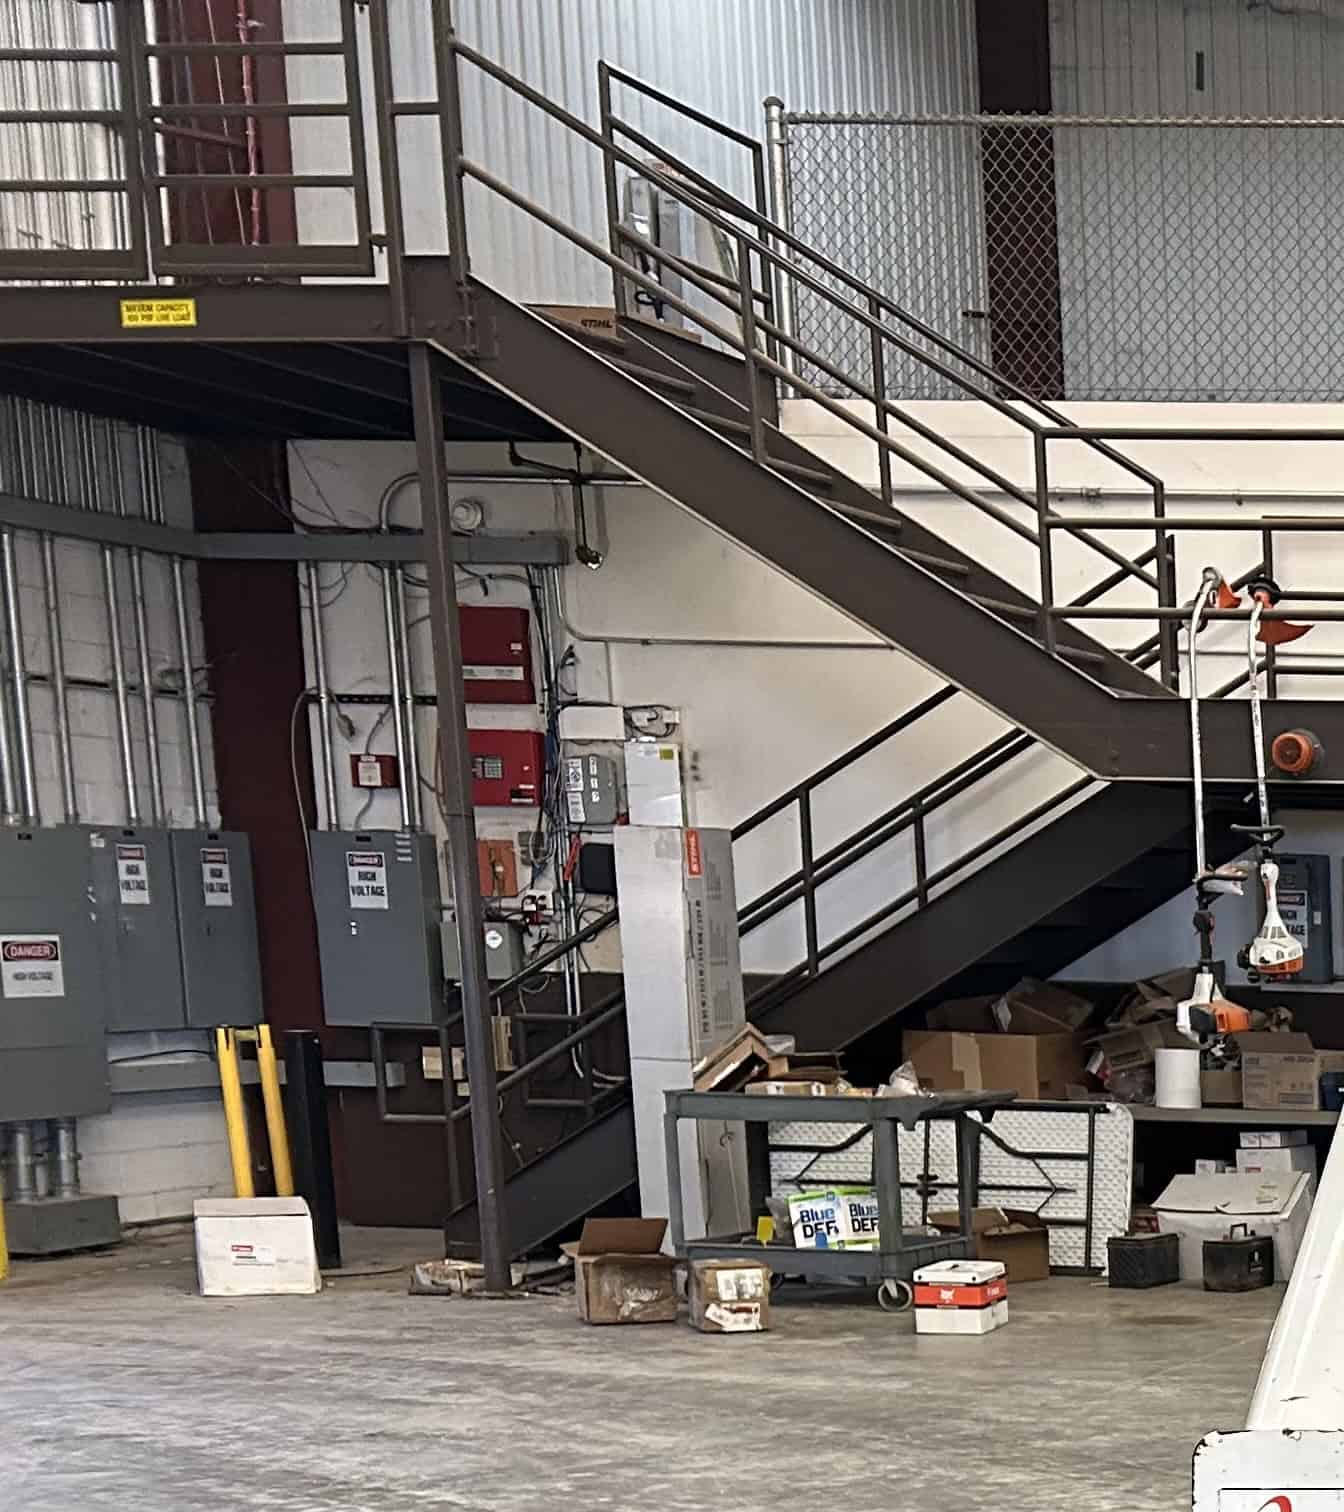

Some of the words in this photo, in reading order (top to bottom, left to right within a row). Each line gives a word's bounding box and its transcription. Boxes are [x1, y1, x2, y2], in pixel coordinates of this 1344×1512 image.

[580, 319, 614, 329] STIHL
[350, 886, 386, 897] VOLTAGE
[10, 944, 50, 957] DANGER
[800, 1207, 835, 1224] Blue
[802, 1220, 837, 1239] DEF
[851, 1217, 880, 1233] DEF
